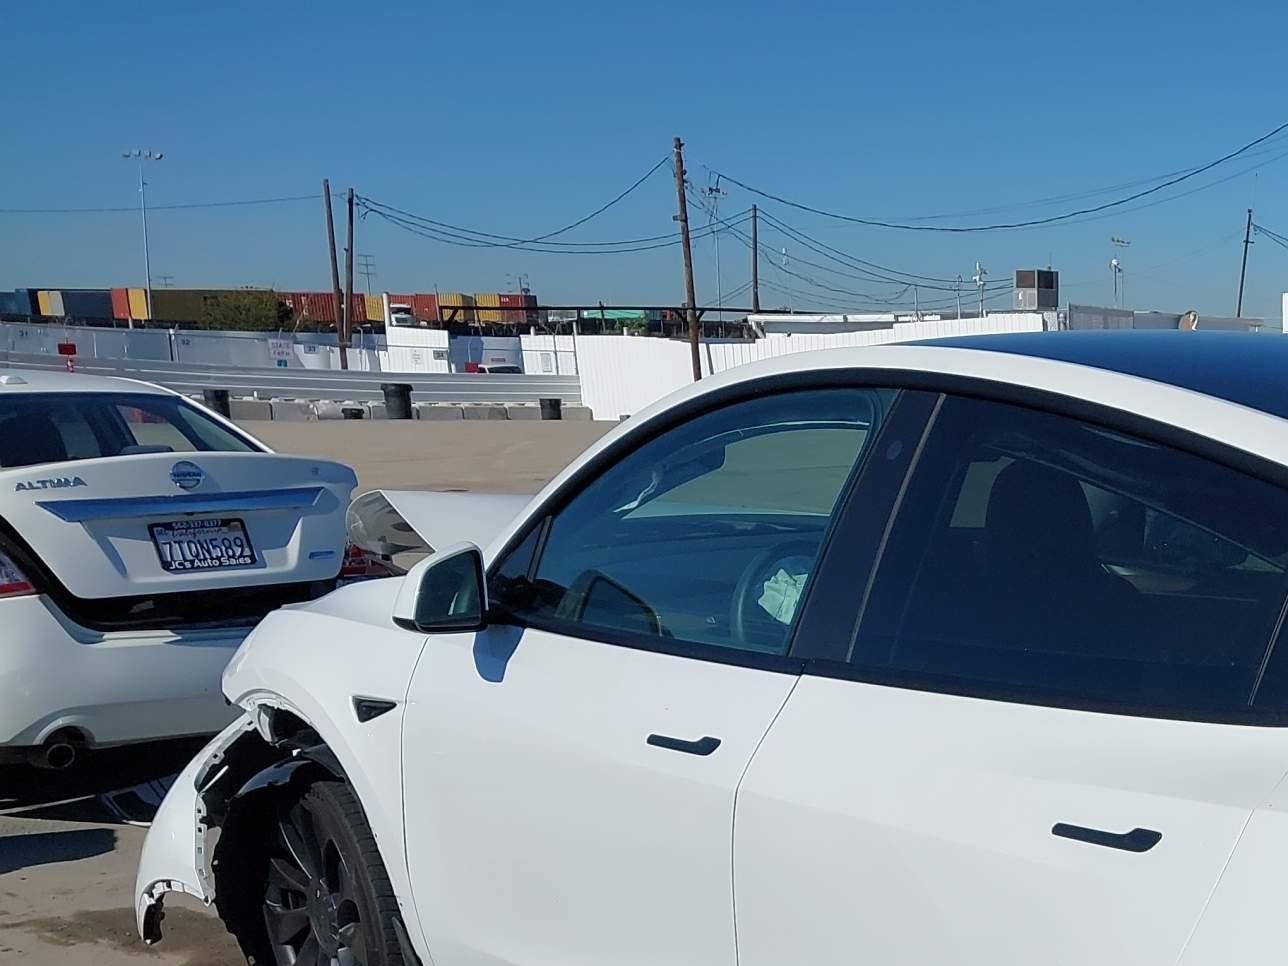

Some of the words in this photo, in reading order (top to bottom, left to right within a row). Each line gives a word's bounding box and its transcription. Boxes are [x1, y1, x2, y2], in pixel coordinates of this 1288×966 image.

[15, 476, 89, 492] ALTIMA
[169, 560, 192, 570] JC's
[194, 559, 220, 569] Auto
[221, 556, 252, 567] Sales
